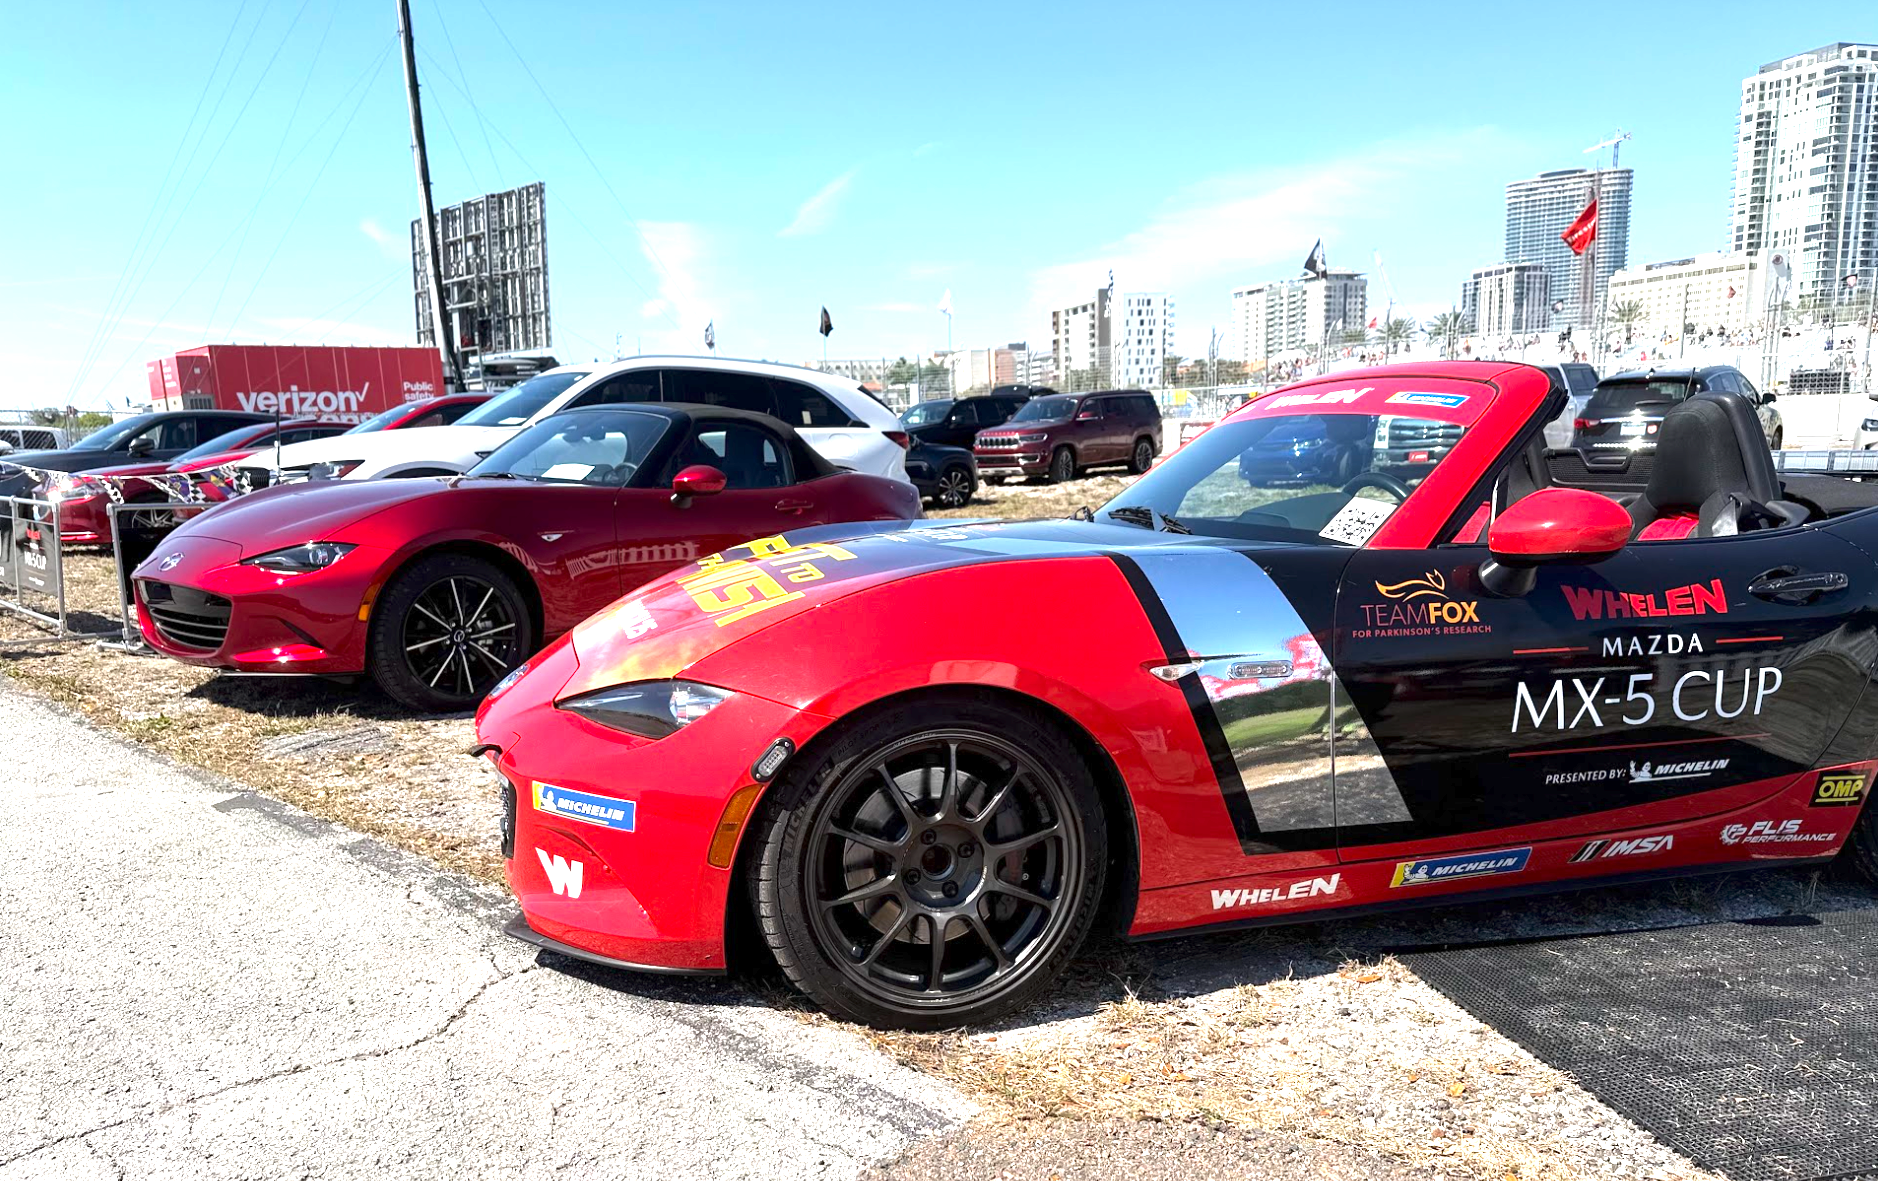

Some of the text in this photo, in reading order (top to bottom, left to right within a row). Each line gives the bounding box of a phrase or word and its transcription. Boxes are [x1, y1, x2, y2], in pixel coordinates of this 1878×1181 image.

[236, 384, 358, 413] verizon
[403, 381, 434, 392] Public
[403, 391, 434, 402] safety
[1560, 578, 1728, 621] WHELEN
[1352, 625, 1492, 639] FOR PARKINSON'S RESEARCH
[1602, 632, 1704, 658] MAZDA
[1511, 666, 1783, 733] MX-5 CUP
[1545, 759, 1730, 785] PRESENTED BY: MICHELIN
[1819, 778, 1864, 798] OMP
[556, 797, 625, 822] MICHELIN
[1741, 832, 1837, 844] PERFORMANCE
[1748, 820, 1803, 836] FLIS
[1602, 834, 1674, 858] IMSA
[534, 847, 584, 899] W
[1431, 857, 1517, 876] MICHELIN
[1210, 873, 1341, 910] WHELEN
